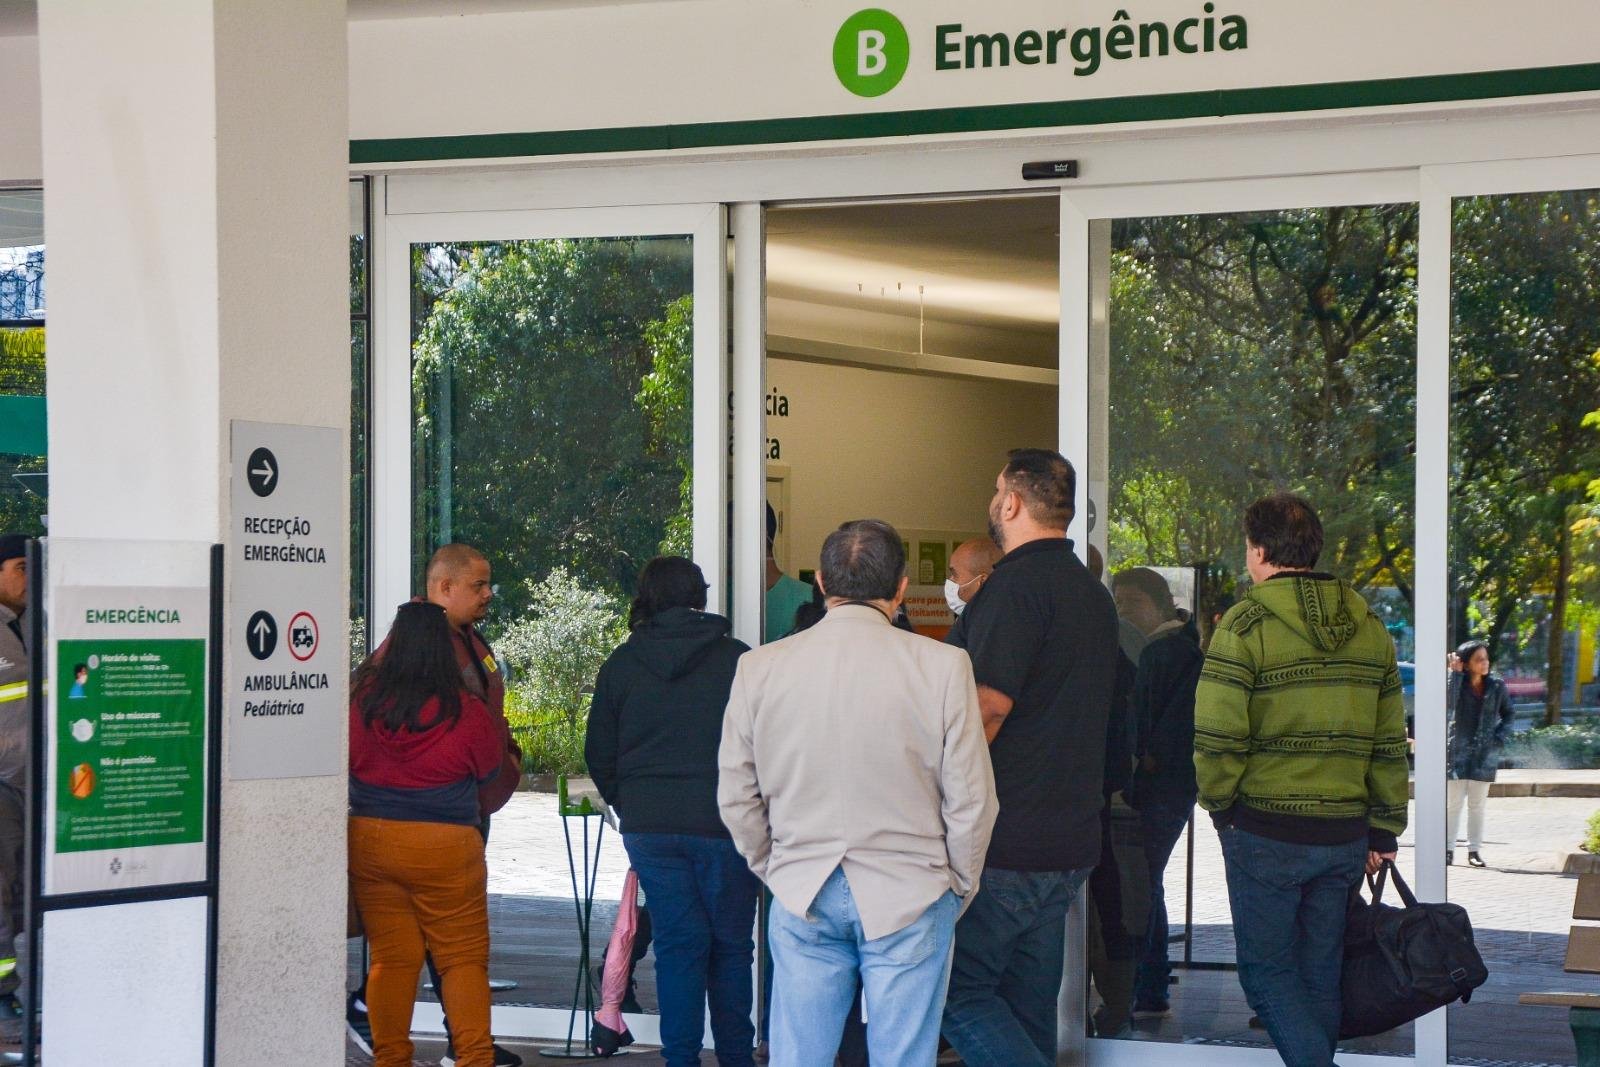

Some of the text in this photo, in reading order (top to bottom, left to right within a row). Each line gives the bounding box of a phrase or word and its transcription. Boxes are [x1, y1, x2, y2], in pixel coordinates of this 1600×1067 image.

[857, 2, 1248, 76] B Emergência
[244, 517, 310, 539] RECEPÇÃO
[244, 543, 326, 563] EMERGÊNCIA
[86, 606, 181, 623] EMERGÊNCIA
[244, 671, 328, 691] AMBULÂNCIA
[244, 700, 304, 717] Pediátrica
